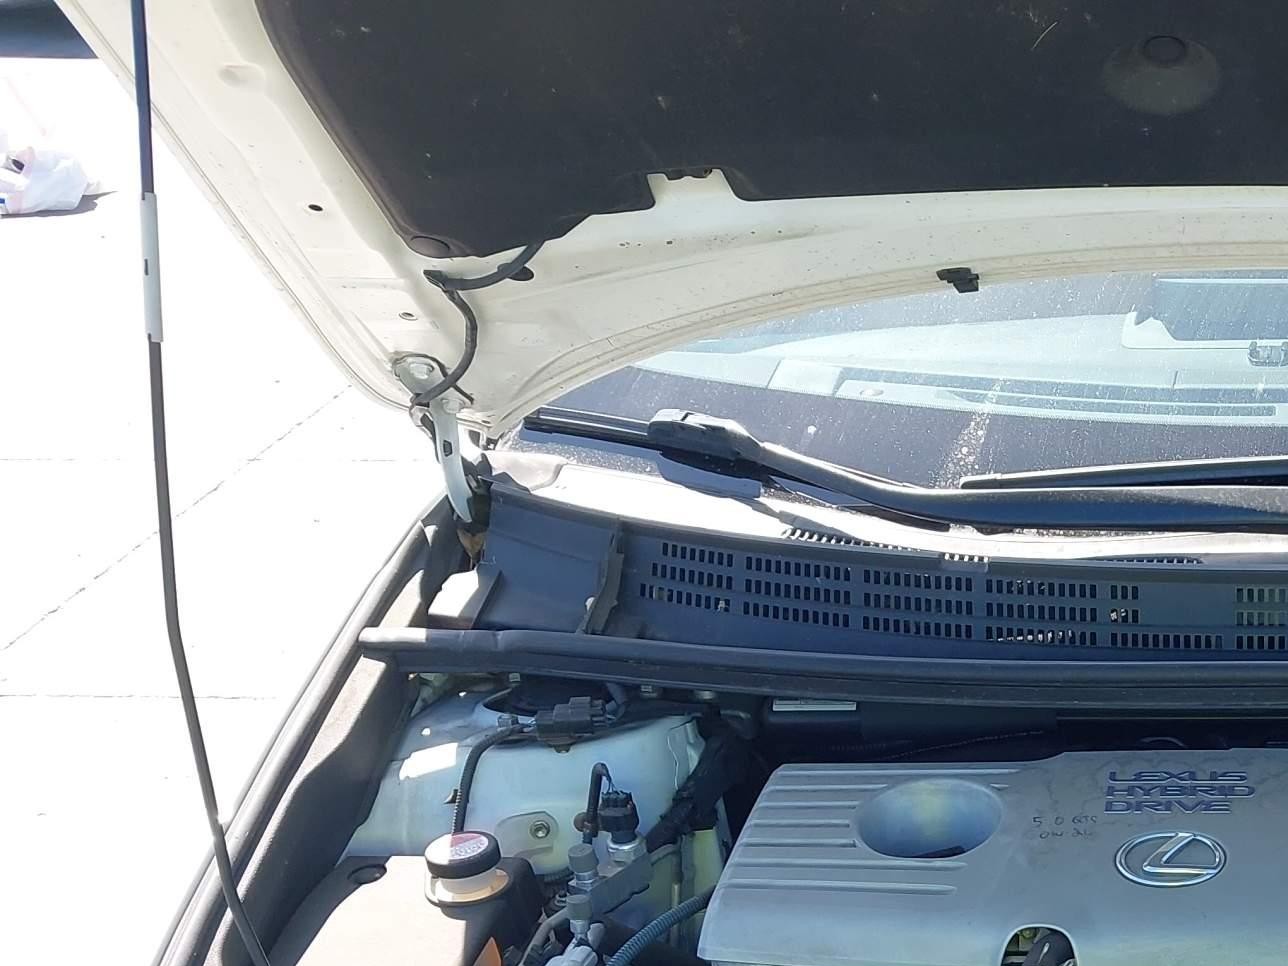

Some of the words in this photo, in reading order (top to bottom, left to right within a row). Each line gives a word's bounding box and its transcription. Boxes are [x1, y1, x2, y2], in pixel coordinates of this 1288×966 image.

[1107, 770, 1249, 783] LEXUS
[1104, 785, 1256, 799] HYBRID
[1103, 800, 1233, 814] DRIVE
